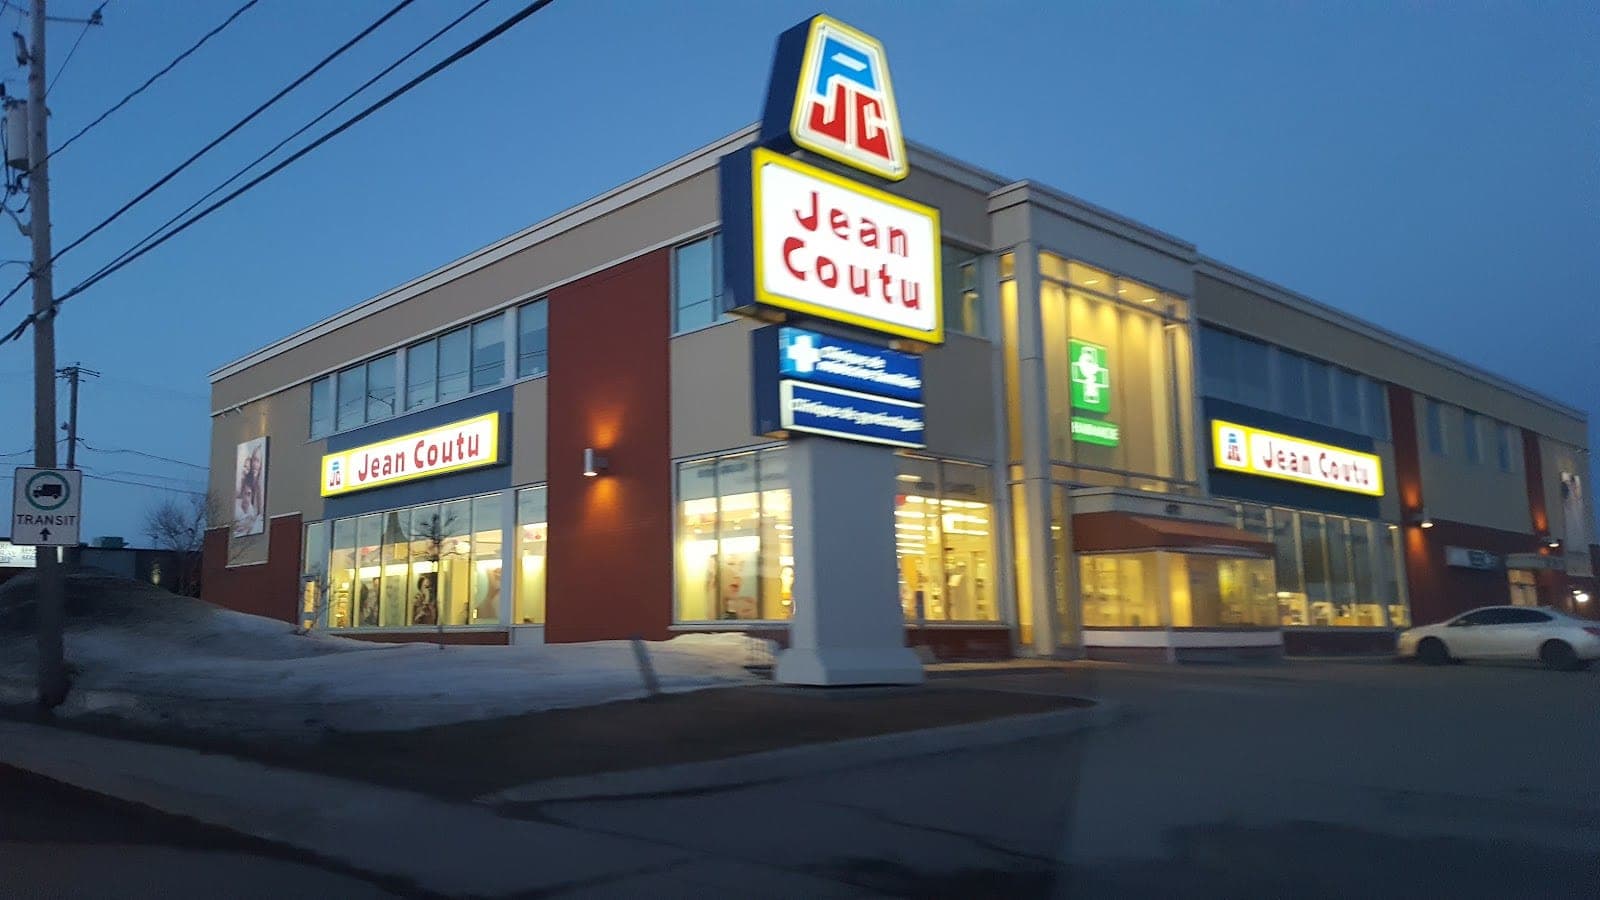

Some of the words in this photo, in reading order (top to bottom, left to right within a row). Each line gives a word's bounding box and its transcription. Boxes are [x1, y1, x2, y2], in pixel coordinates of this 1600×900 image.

[794, 191, 909, 257] Jean
[782, 235, 920, 310] Coutu
[358, 451, 405, 482] Jean
[414, 432, 479, 468] Coutu
[1262, 440, 1312, 475] Jean
[1319, 452, 1369, 486] Coutu
[16, 514, 77, 526] TRANSIT
